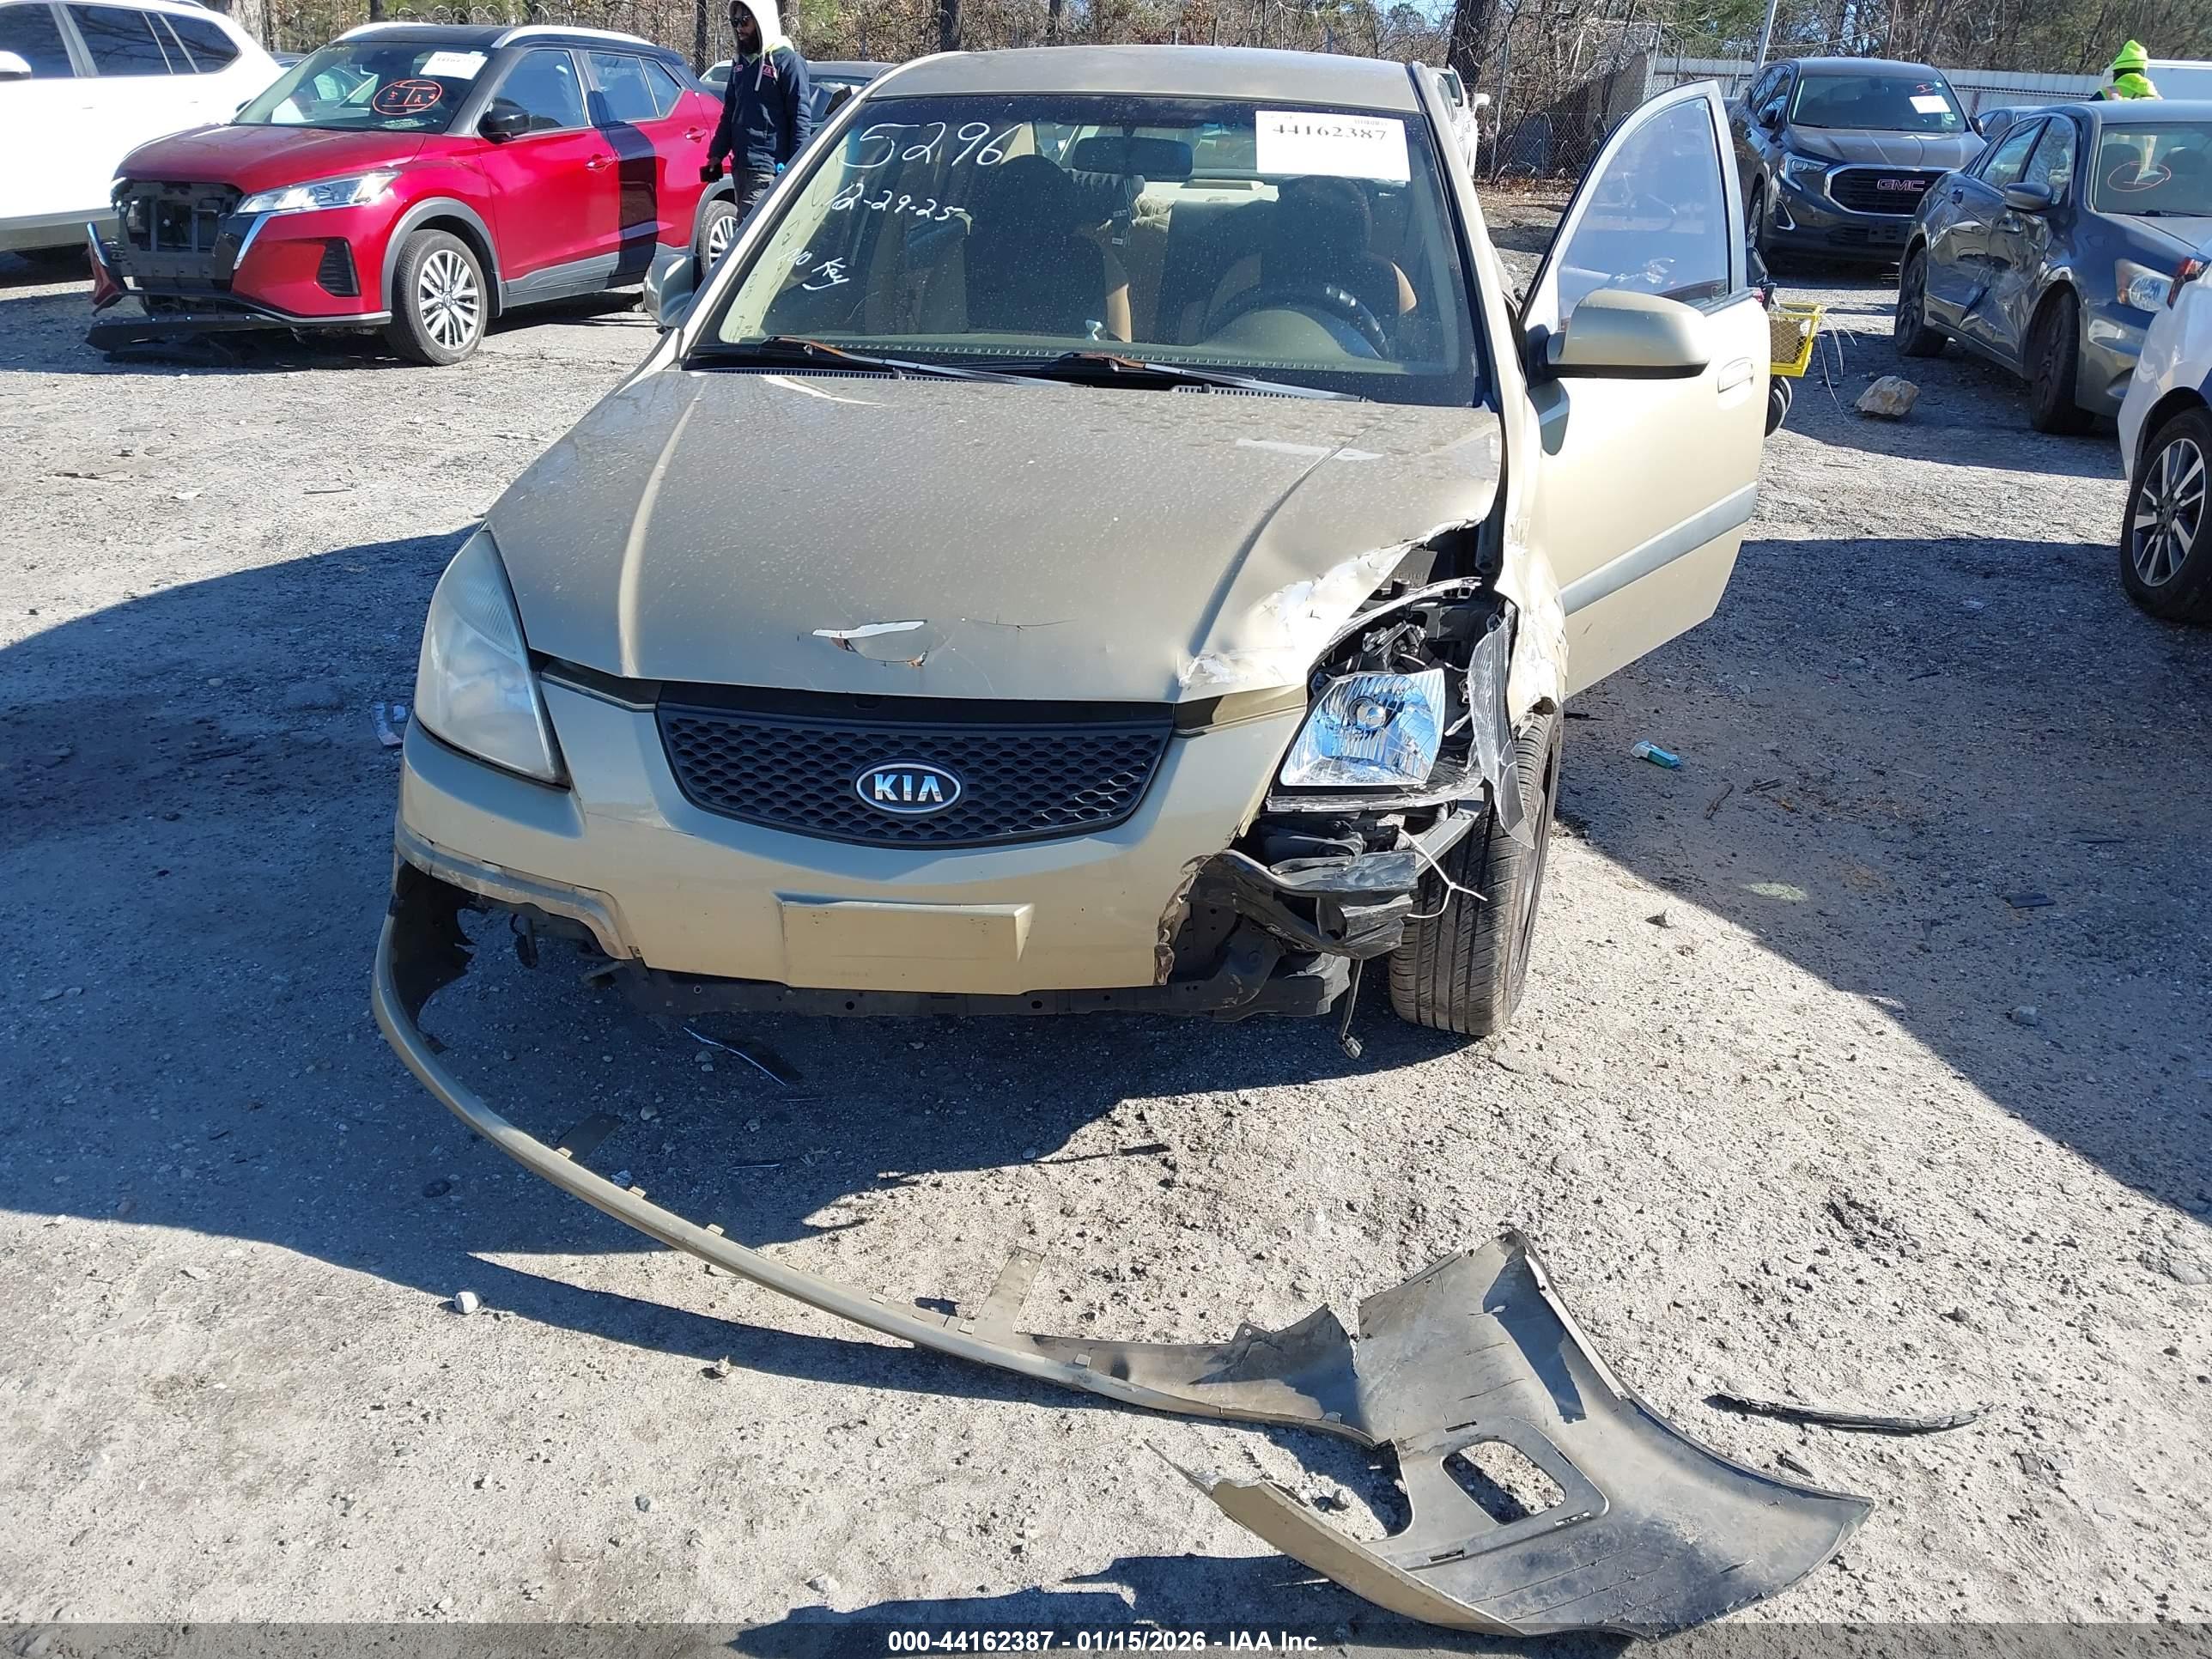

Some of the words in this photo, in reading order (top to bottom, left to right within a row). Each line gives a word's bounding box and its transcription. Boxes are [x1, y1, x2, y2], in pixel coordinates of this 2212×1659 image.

[836, 121, 1024, 167] 5296
[1272, 124, 1388, 140] 44162387
[1876, 179, 1925, 191] GMC
[824, 183, 965, 221] 12-29-25
[874, 774, 944, 802] KIA
